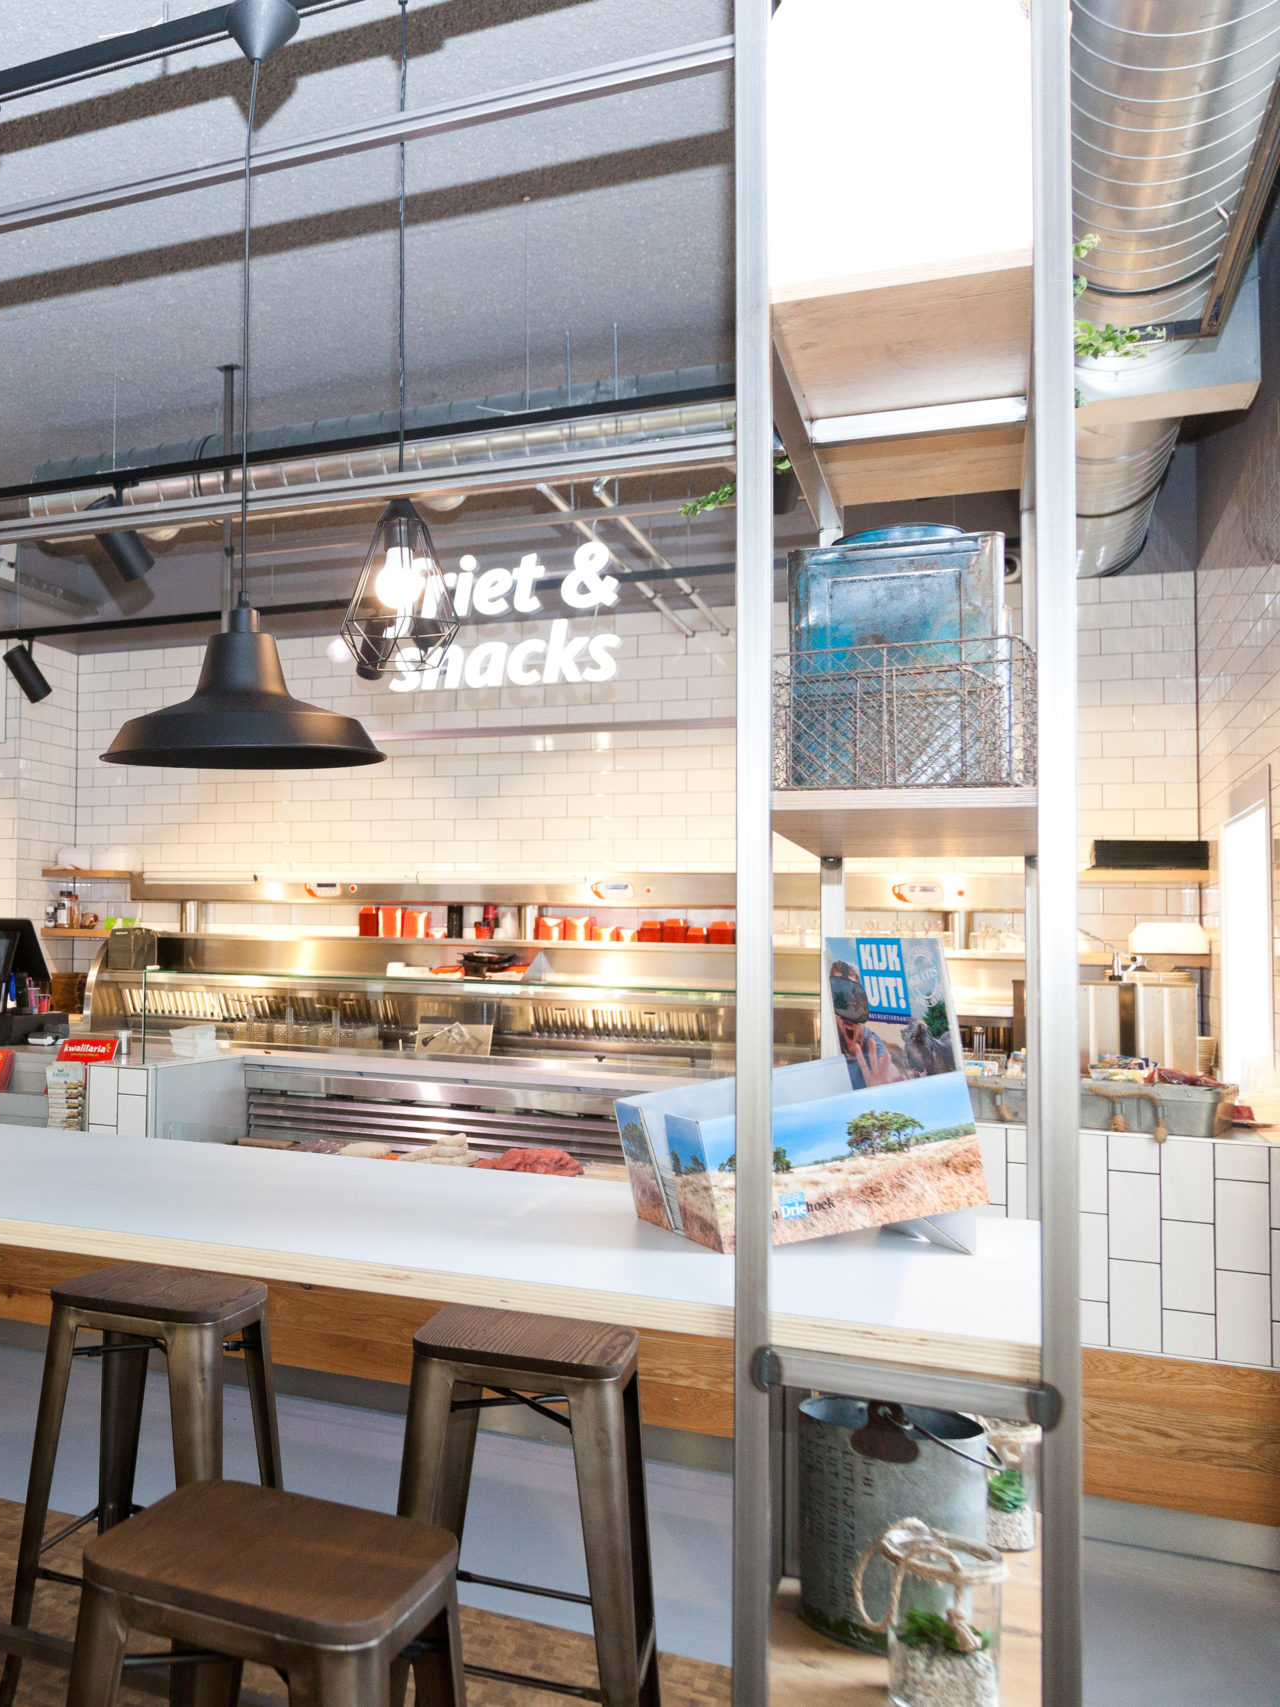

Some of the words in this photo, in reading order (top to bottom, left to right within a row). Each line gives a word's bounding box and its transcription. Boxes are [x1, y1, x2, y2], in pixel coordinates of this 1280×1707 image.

[561, 541, 620, 608] &
[388, 618, 622, 693] snacks
[858, 943, 901, 972] KIJK
[863, 975, 907, 1010] UIT!
[63, 1043, 107, 1053] kwalitaria
